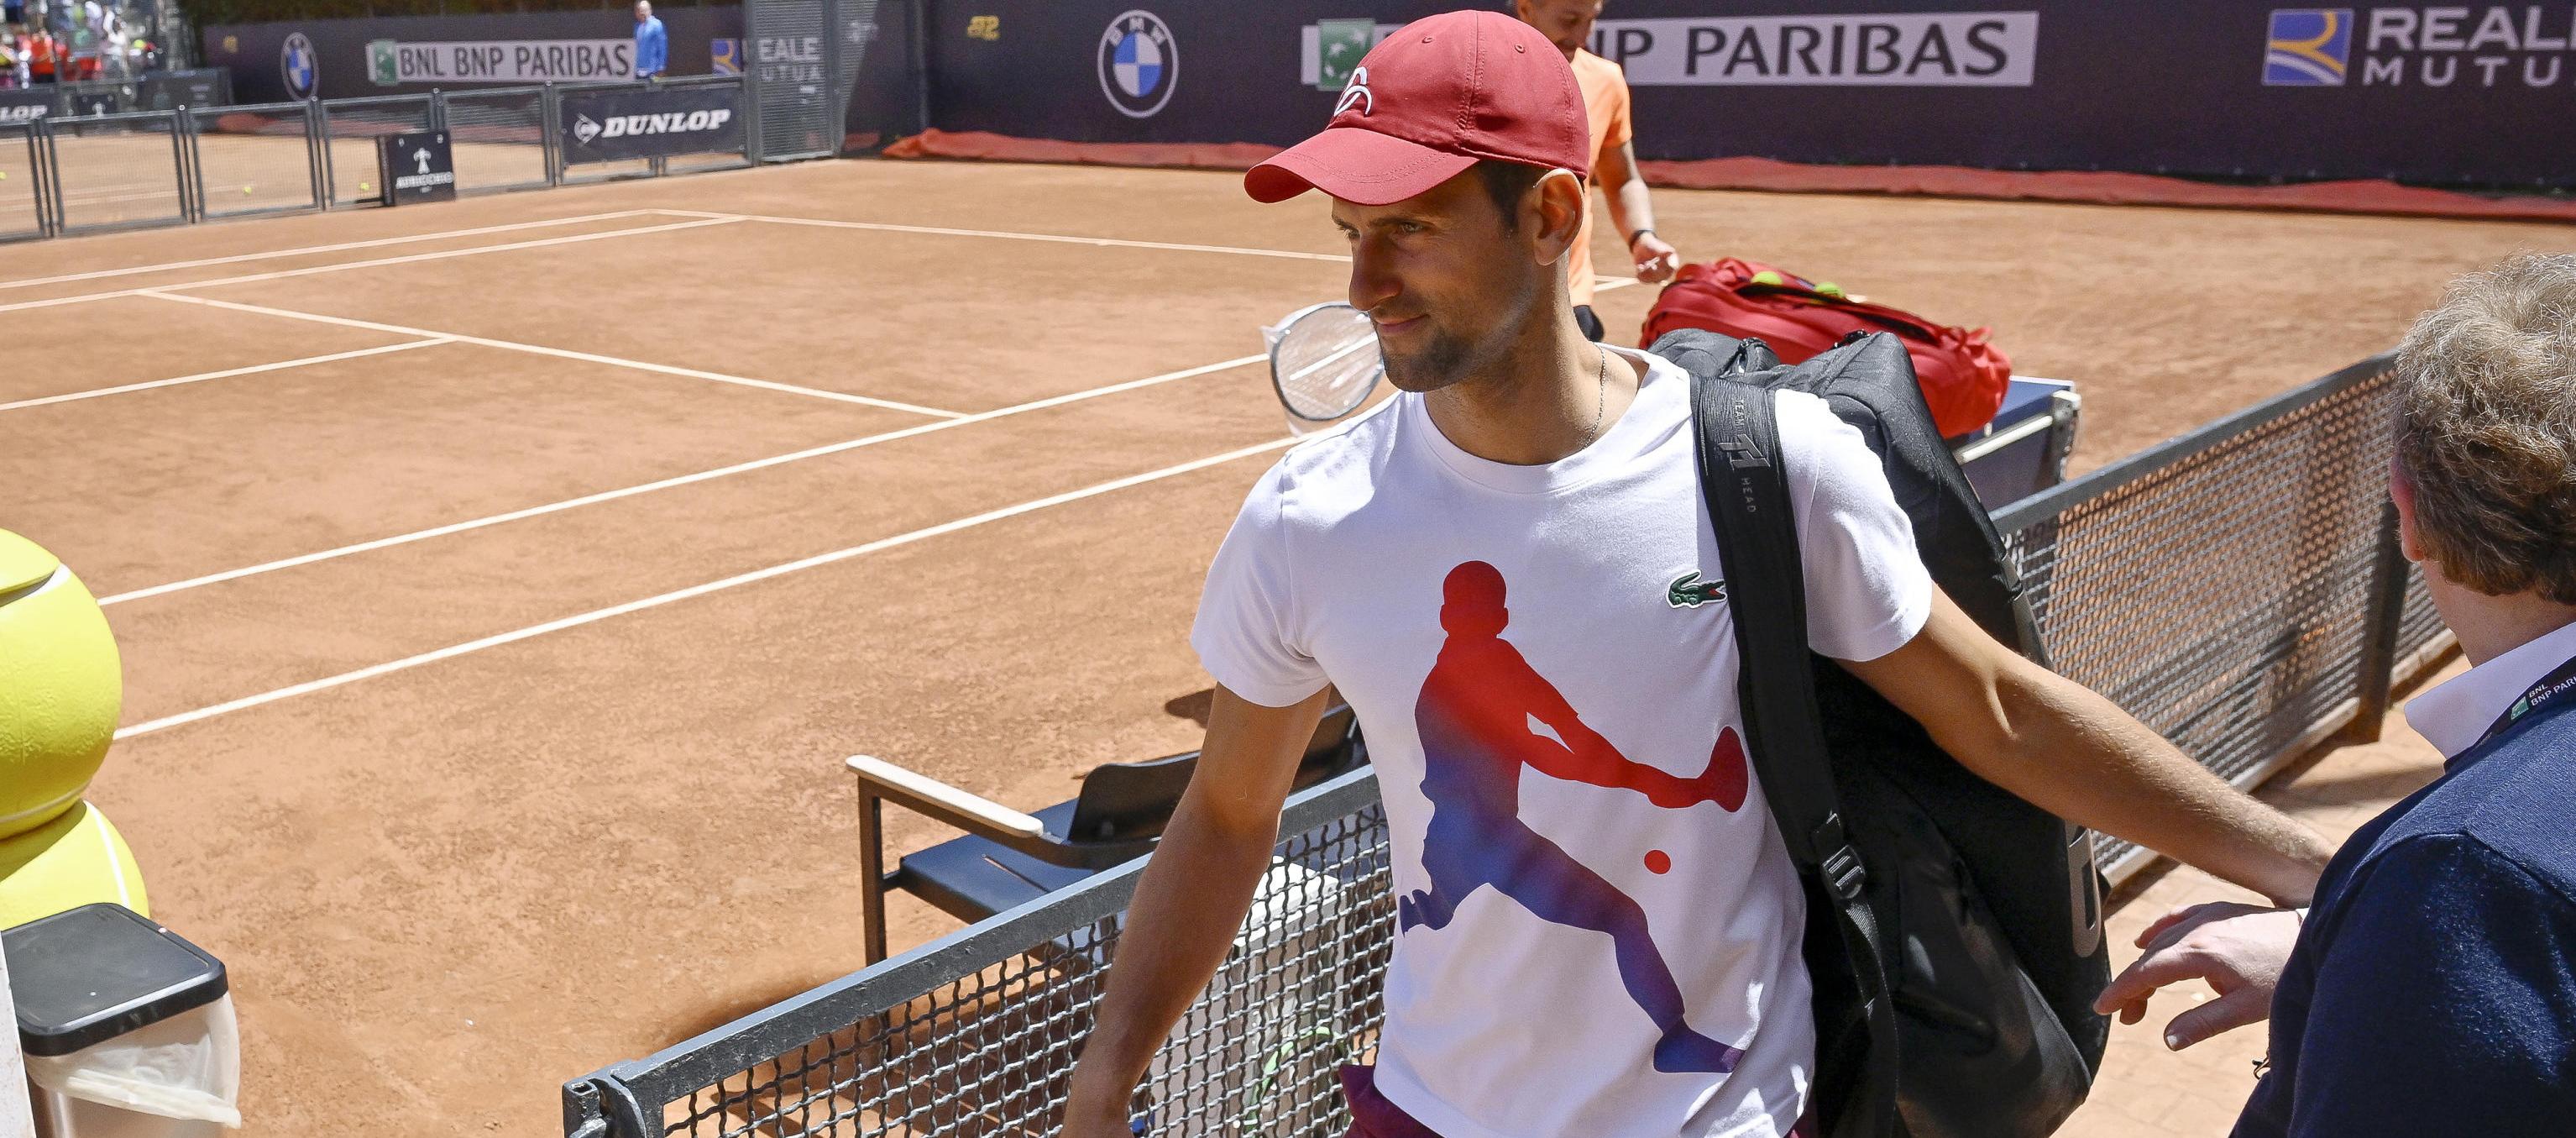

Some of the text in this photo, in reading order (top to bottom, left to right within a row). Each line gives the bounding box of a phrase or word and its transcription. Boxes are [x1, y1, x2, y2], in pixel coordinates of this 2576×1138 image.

[2365, 4, 2576, 52] REAL
[399, 43, 630, 76] BNL BNP PARIBAS
[1684, 20, 2008, 76] PARIBAS
[2362, 55, 2576, 87] MUTU
[601, 108, 732, 139] DUNLOP
[1741, 477, 1757, 512] HEAD
[2529, 684, 2548, 698] BNL
[2531, 690, 2552, 705] BNP
